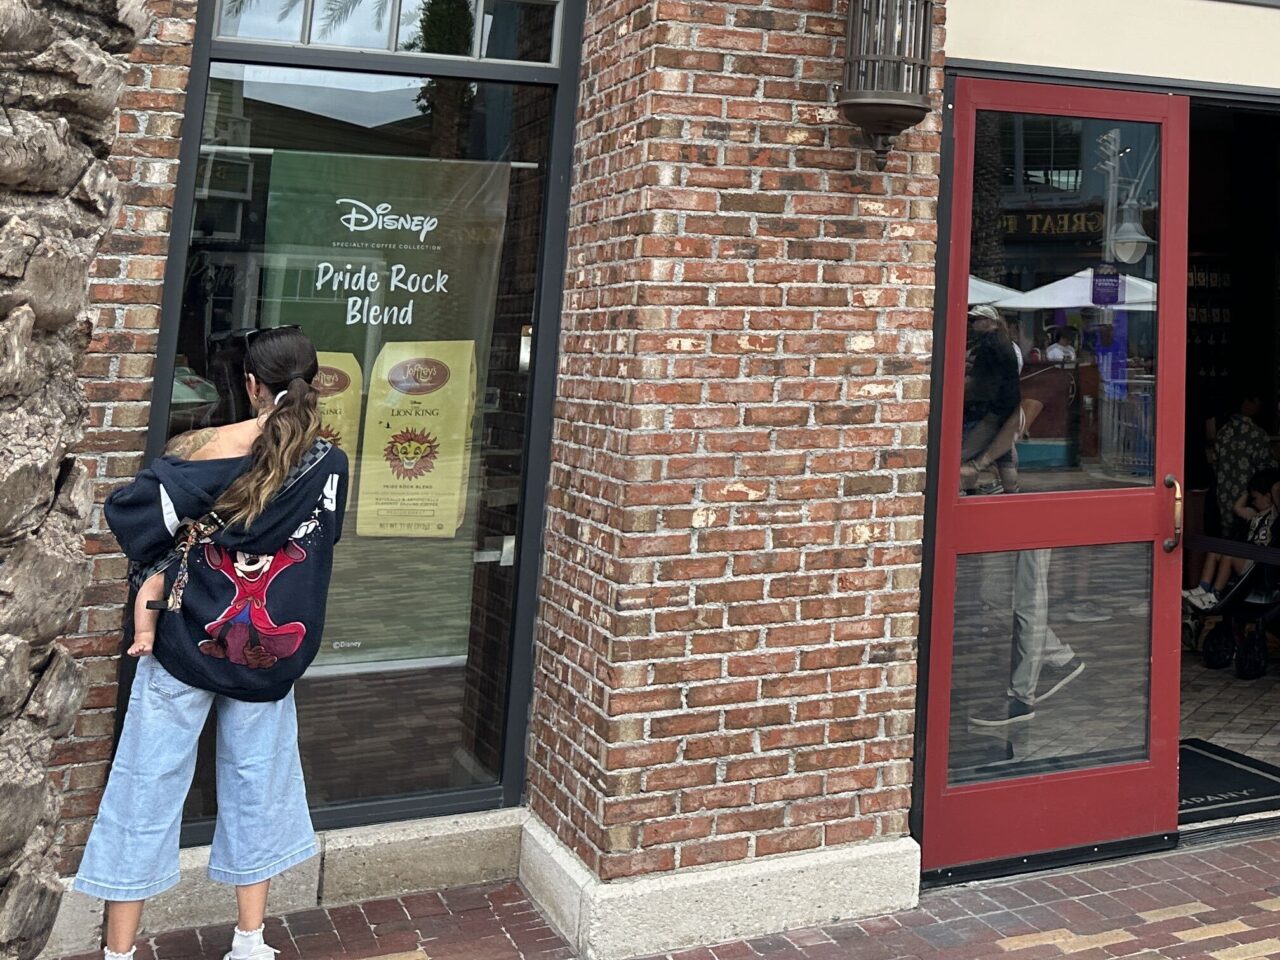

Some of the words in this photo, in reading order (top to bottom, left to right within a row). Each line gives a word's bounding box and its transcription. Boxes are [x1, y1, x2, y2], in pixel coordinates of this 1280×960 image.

[332, 241, 369, 249] SPECIALTY
[315, 262, 380, 293] Pride
[389, 263, 449, 294] Rock
[346, 296, 414, 325] Blend
[391, 408, 413, 417] LION
[414, 408, 439, 417] KING
